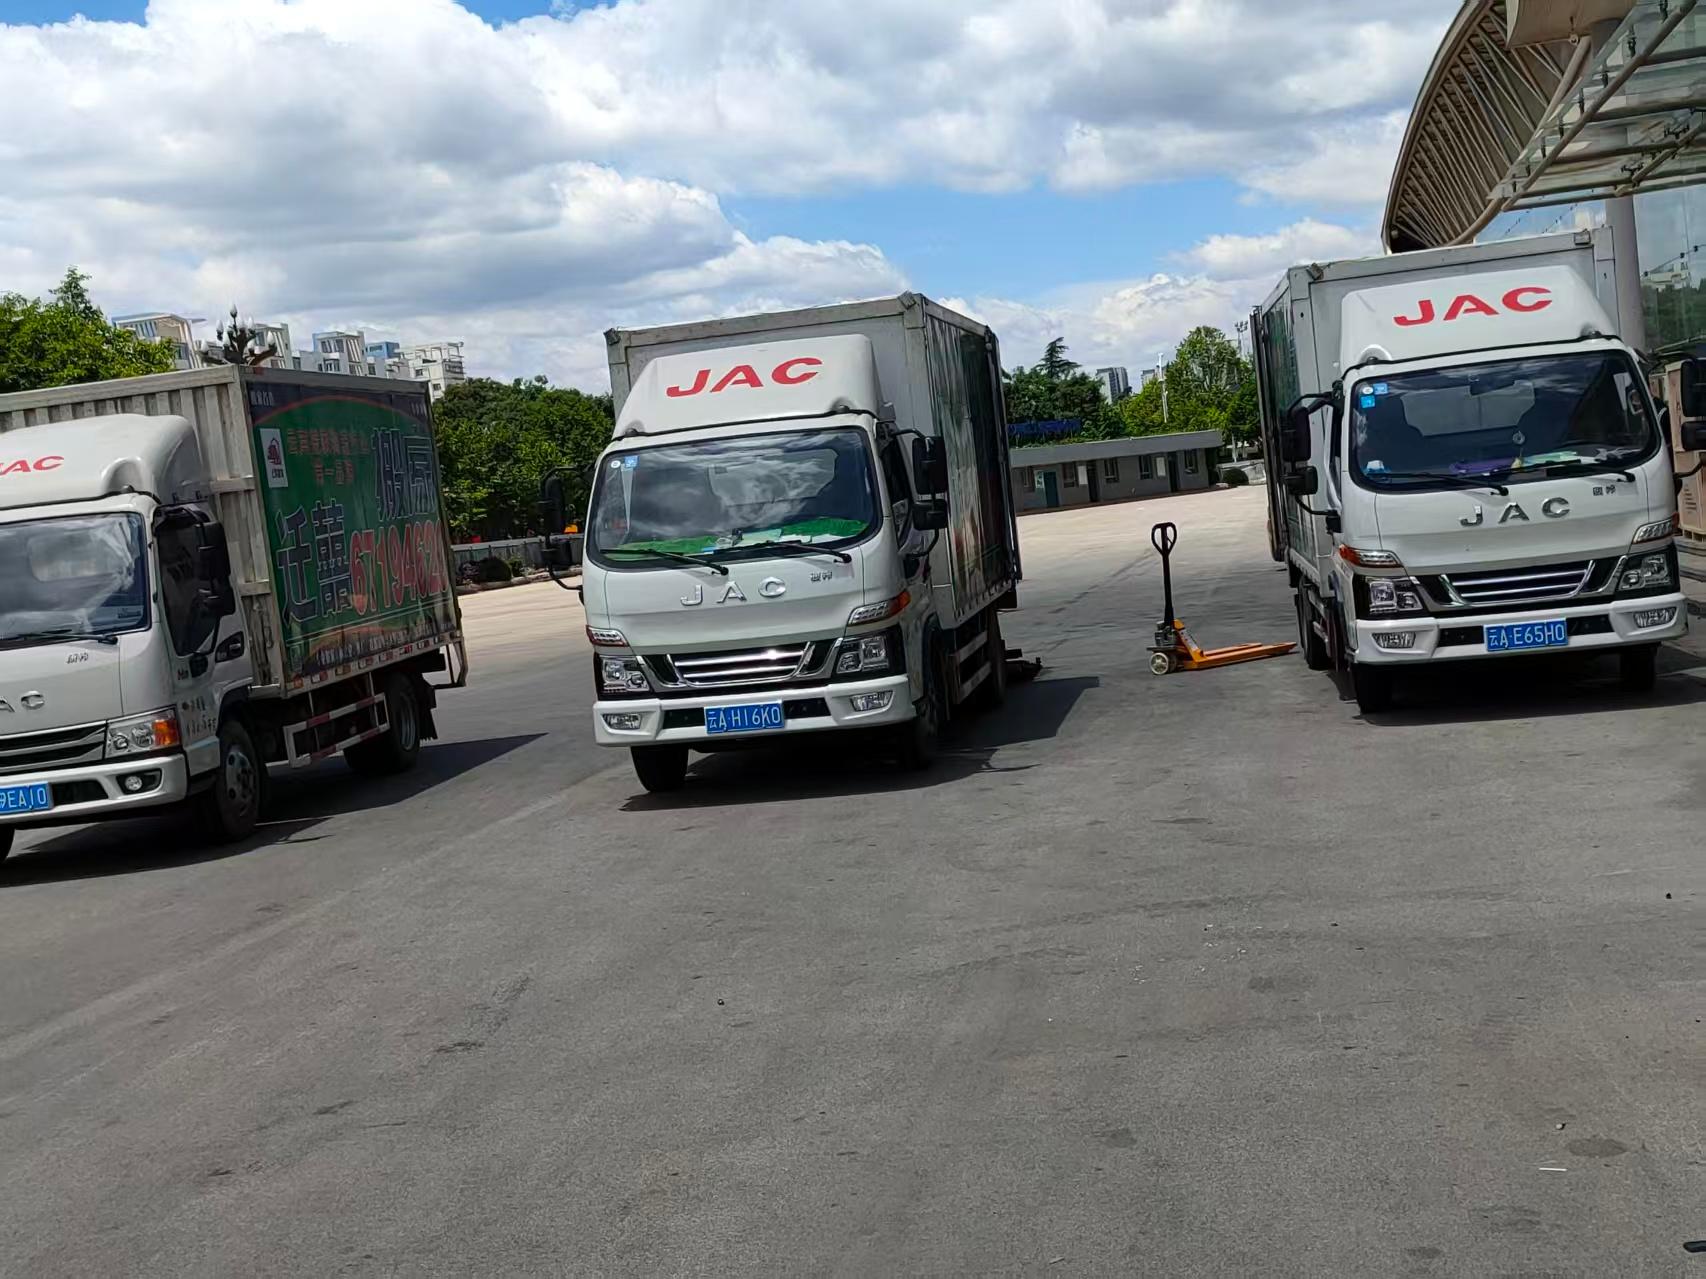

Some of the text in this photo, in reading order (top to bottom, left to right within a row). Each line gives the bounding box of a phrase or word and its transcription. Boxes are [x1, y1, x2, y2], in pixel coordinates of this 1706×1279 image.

[1394, 286, 1553, 327] JAC
[665, 356, 823, 398] JAC
[0, 455, 64, 476] AC
[1460, 497, 1571, 528] JAC
[680, 576, 786, 606] JAC
